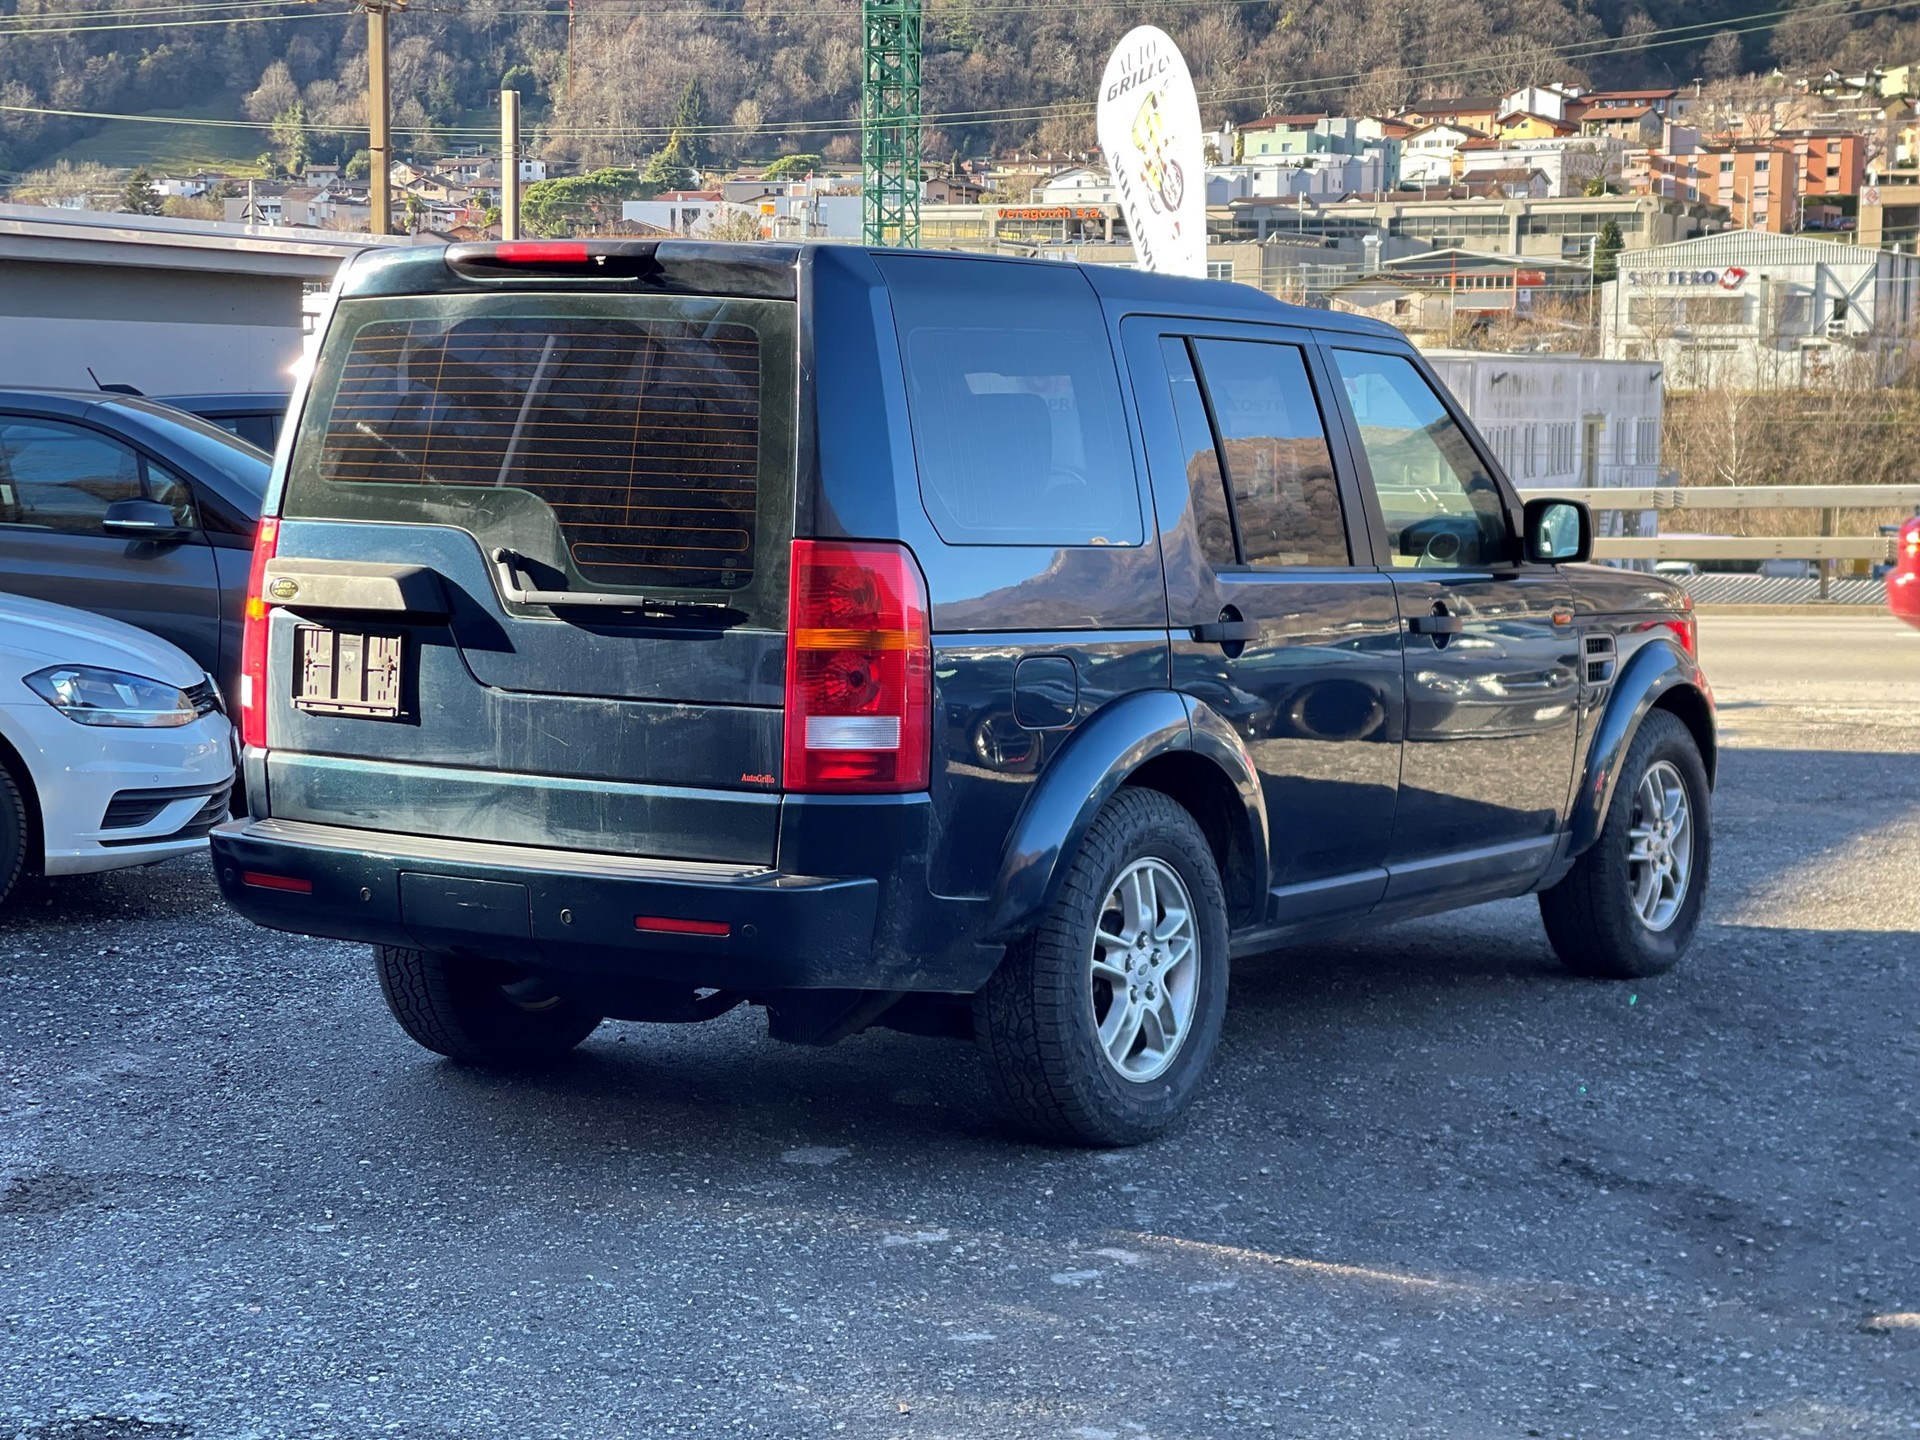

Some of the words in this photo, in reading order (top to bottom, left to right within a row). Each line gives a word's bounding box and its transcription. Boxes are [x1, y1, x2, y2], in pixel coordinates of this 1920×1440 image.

[997, 206, 1071, 221] veragouth
[1076, 207, 1102, 218] s.a.
[741, 773, 775, 784] AutoGrillo
